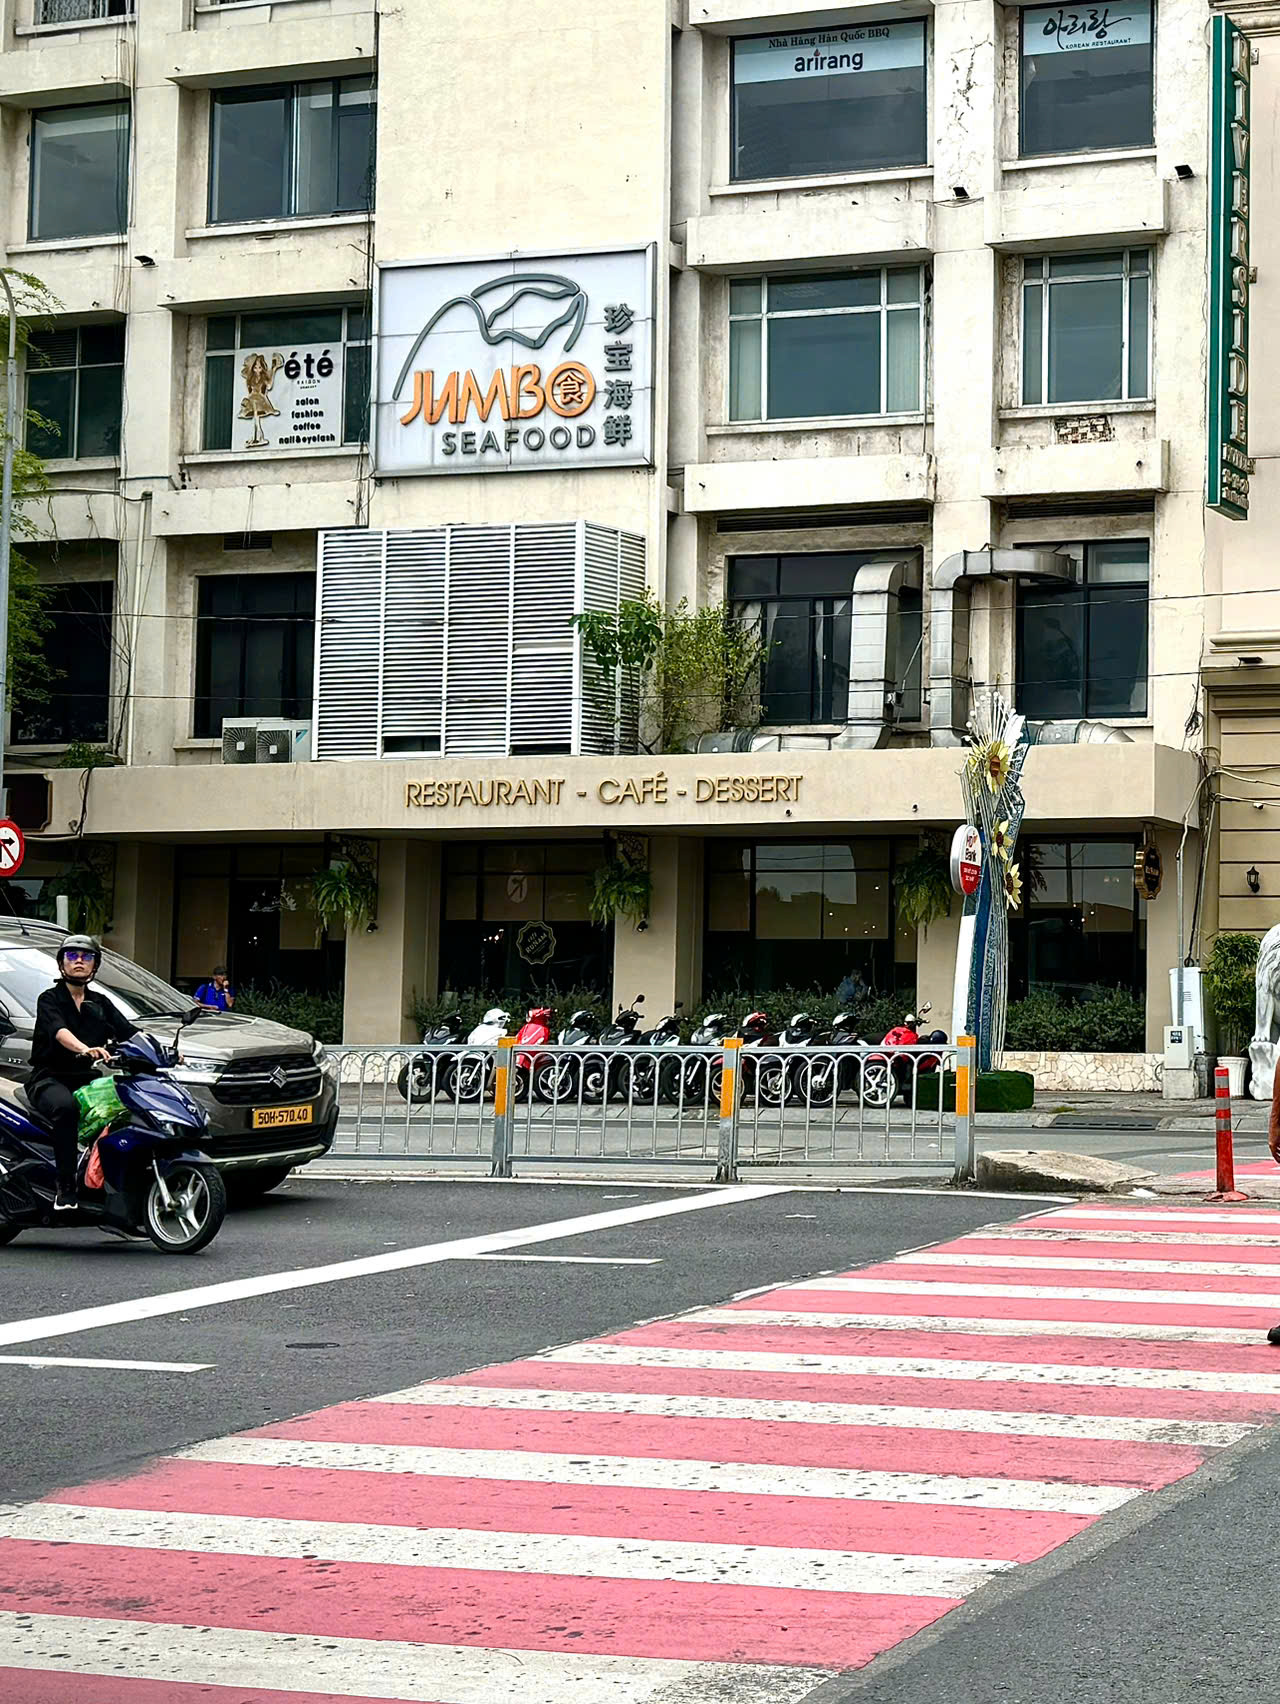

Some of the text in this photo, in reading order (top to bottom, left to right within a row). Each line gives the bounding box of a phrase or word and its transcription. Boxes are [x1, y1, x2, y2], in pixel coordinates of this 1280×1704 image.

[768, 38, 788, 48] Nhà
[818, 33, 838, 44] Hàn
[840, 29, 865, 42] Quốc
[867, 27, 890, 38] BBQ
[1042, 8, 1132, 50] 아리랑
[1065, 38, 1132, 50] KOREAN RESTAURANT
[794, 48, 864, 72] arirang
[1229, 31, 1250, 445] RIVERSIDE
[284, 349, 334, 379] été
[603, 302, 635, 447] 珍宝海鲜
[296, 398, 319, 406] salon
[399, 360, 597, 426] JUMBO
[291, 410, 324, 419] fashion
[293, 422, 321, 431] coffee
[279, 434, 335, 444] nail&eyelash
[441, 424, 596, 456] SEAFOOD
[405, 778, 565, 807] RESTAURANT
[597, 771, 668, 805] CAFÉ
[695, 774, 803, 803] DESSERT
